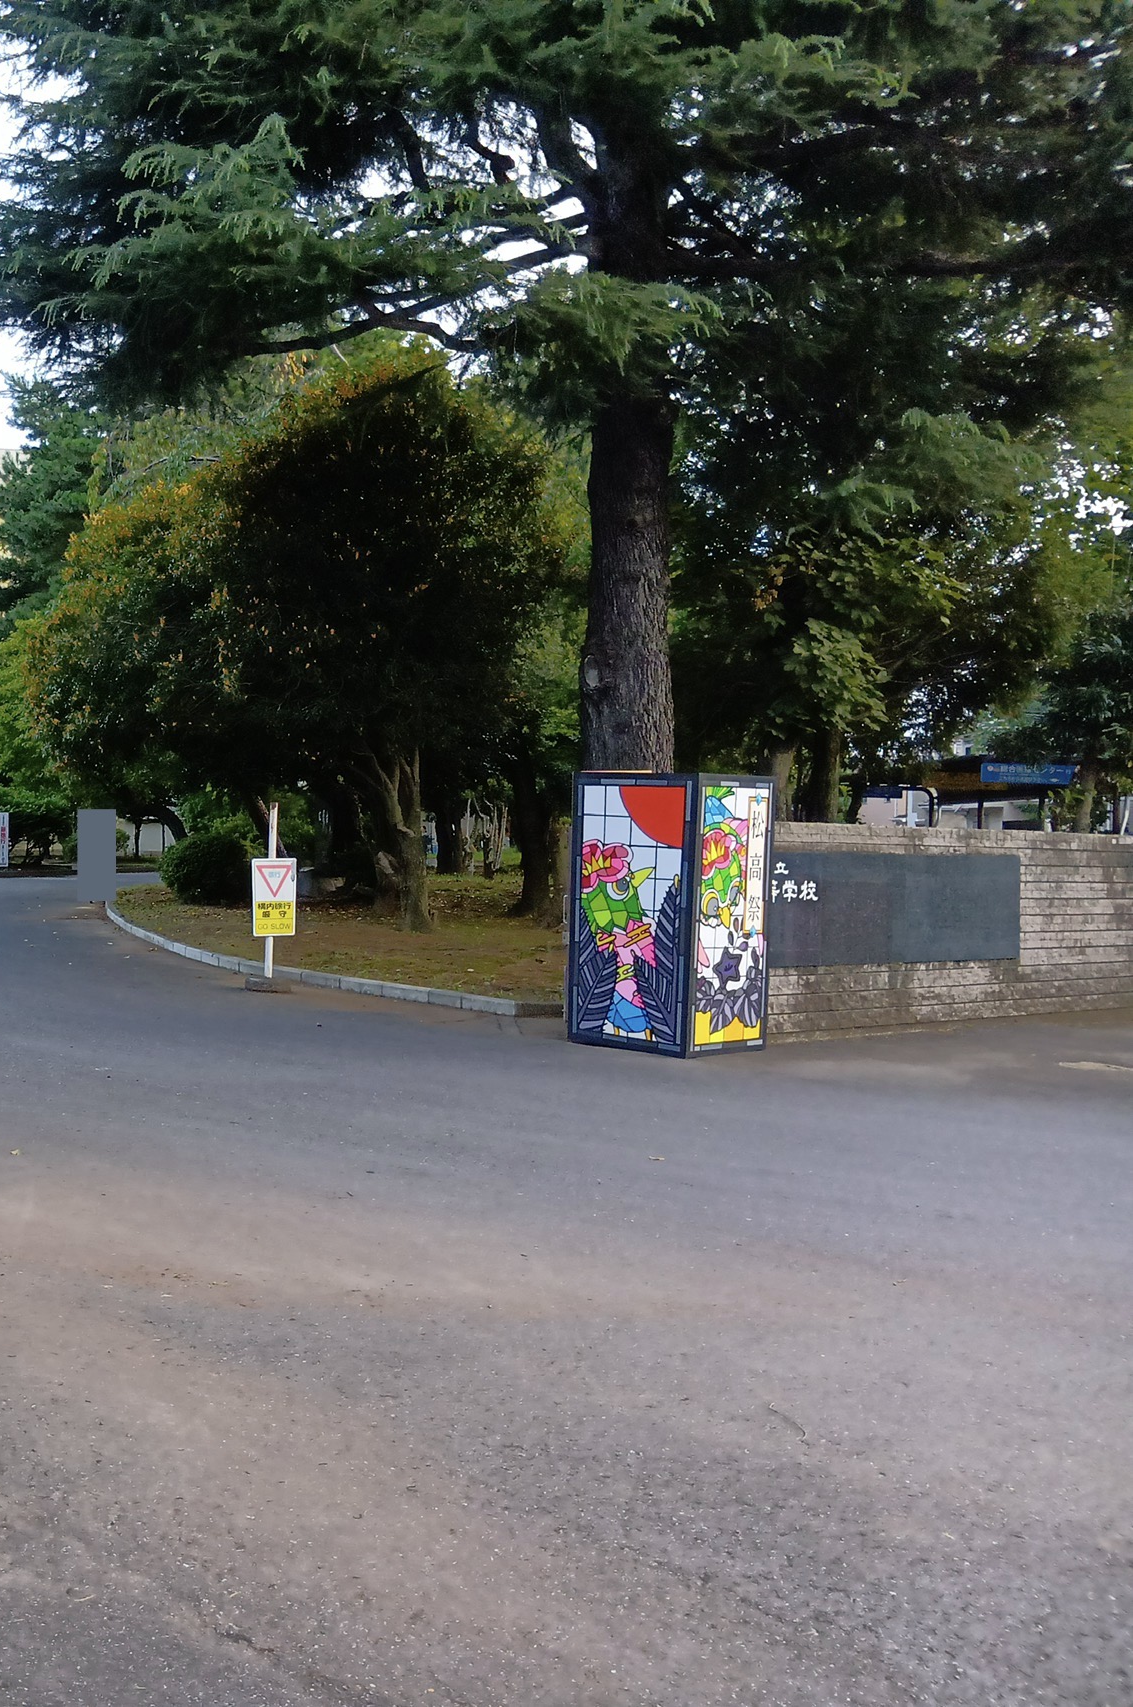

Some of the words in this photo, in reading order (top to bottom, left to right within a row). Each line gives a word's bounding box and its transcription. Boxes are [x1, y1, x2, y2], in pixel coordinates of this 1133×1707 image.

[747, 810, 765, 922] 松高祭
[270, 922, 291, 930] SLOW
